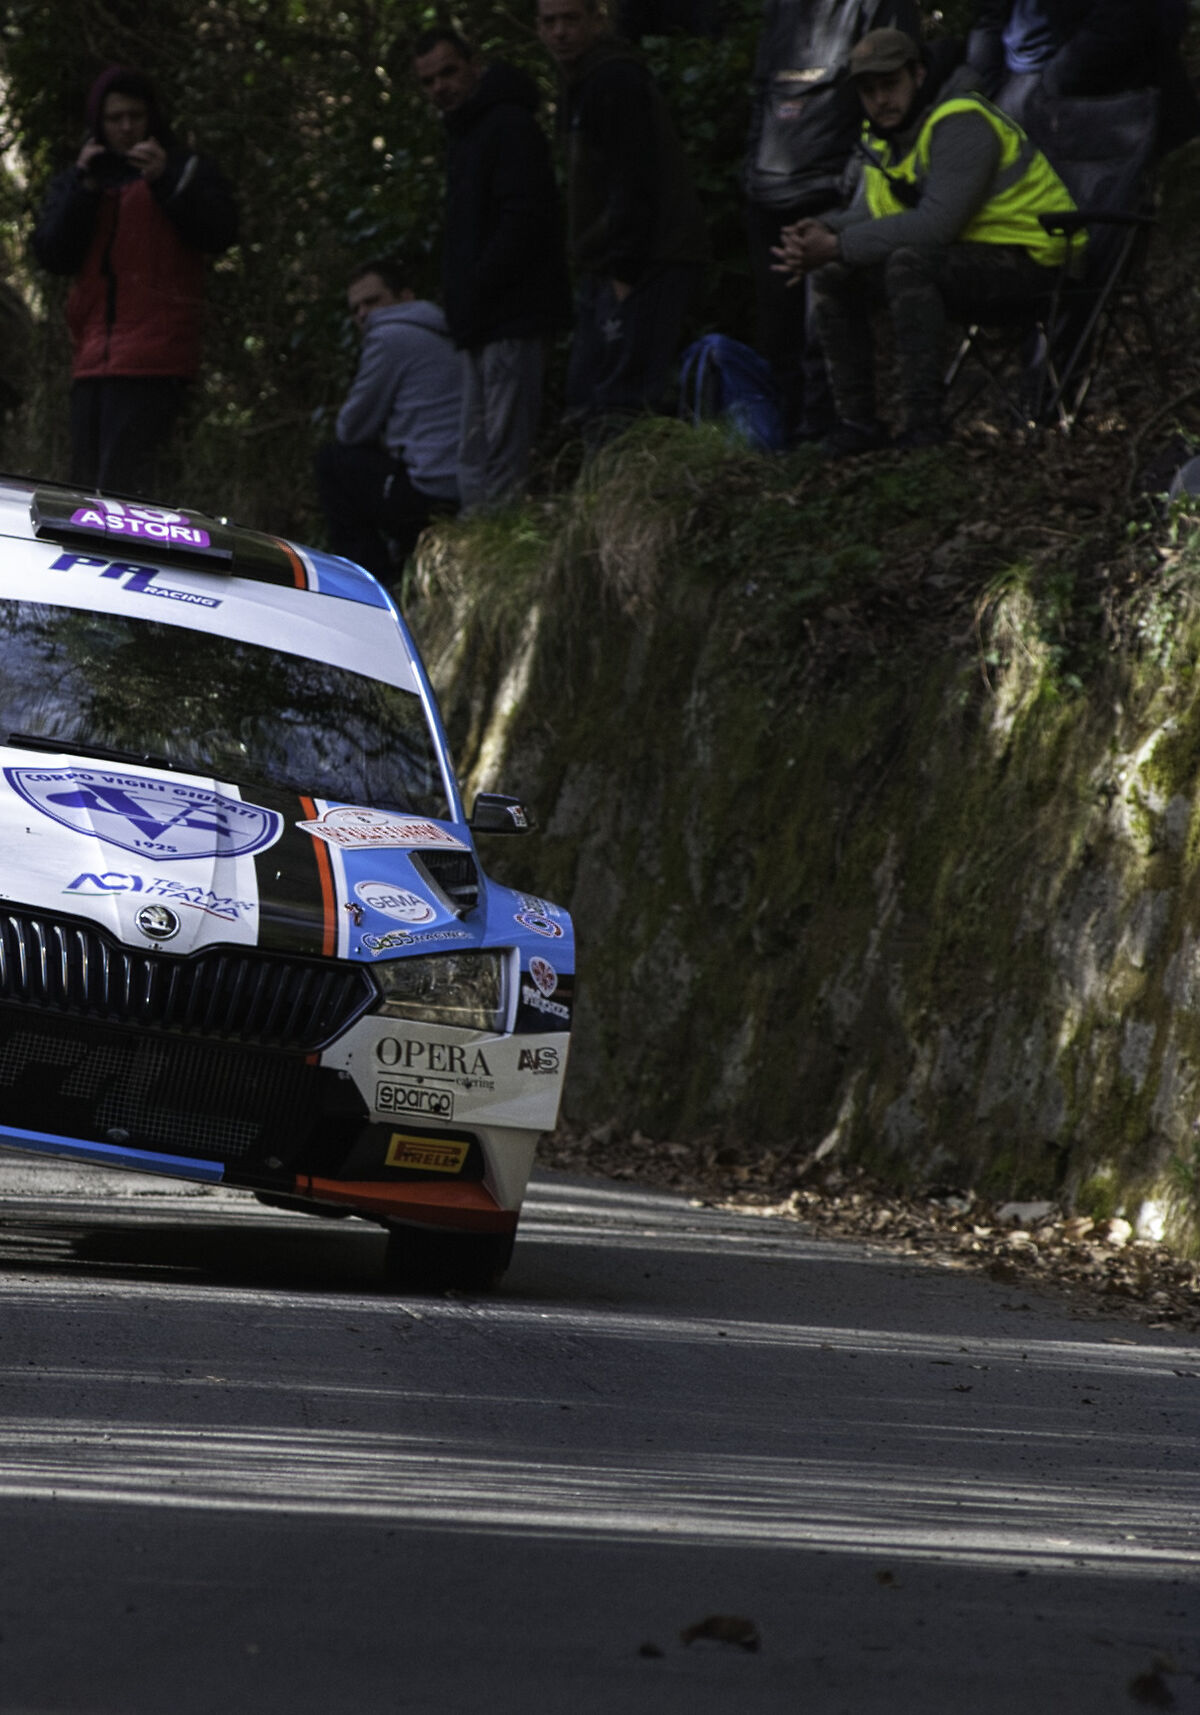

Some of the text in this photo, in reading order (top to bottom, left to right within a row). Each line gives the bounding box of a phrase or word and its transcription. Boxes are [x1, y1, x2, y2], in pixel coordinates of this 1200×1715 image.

[81, 511, 201, 543] ASTORI
[143, 586, 216, 606] RACING
[25, 771, 259, 819] CORPO VIGILI GIURATI
[133, 839, 178, 854] 1925
[67, 872, 233, 905] ACI TEAM
[145, 887, 239, 918] ITALIA
[366, 895, 425, 909] GEMA
[376, 1037, 493, 1077] OPERA
[456, 1075, 495, 1090] catering
[380, 1085, 450, 1111] sparco
